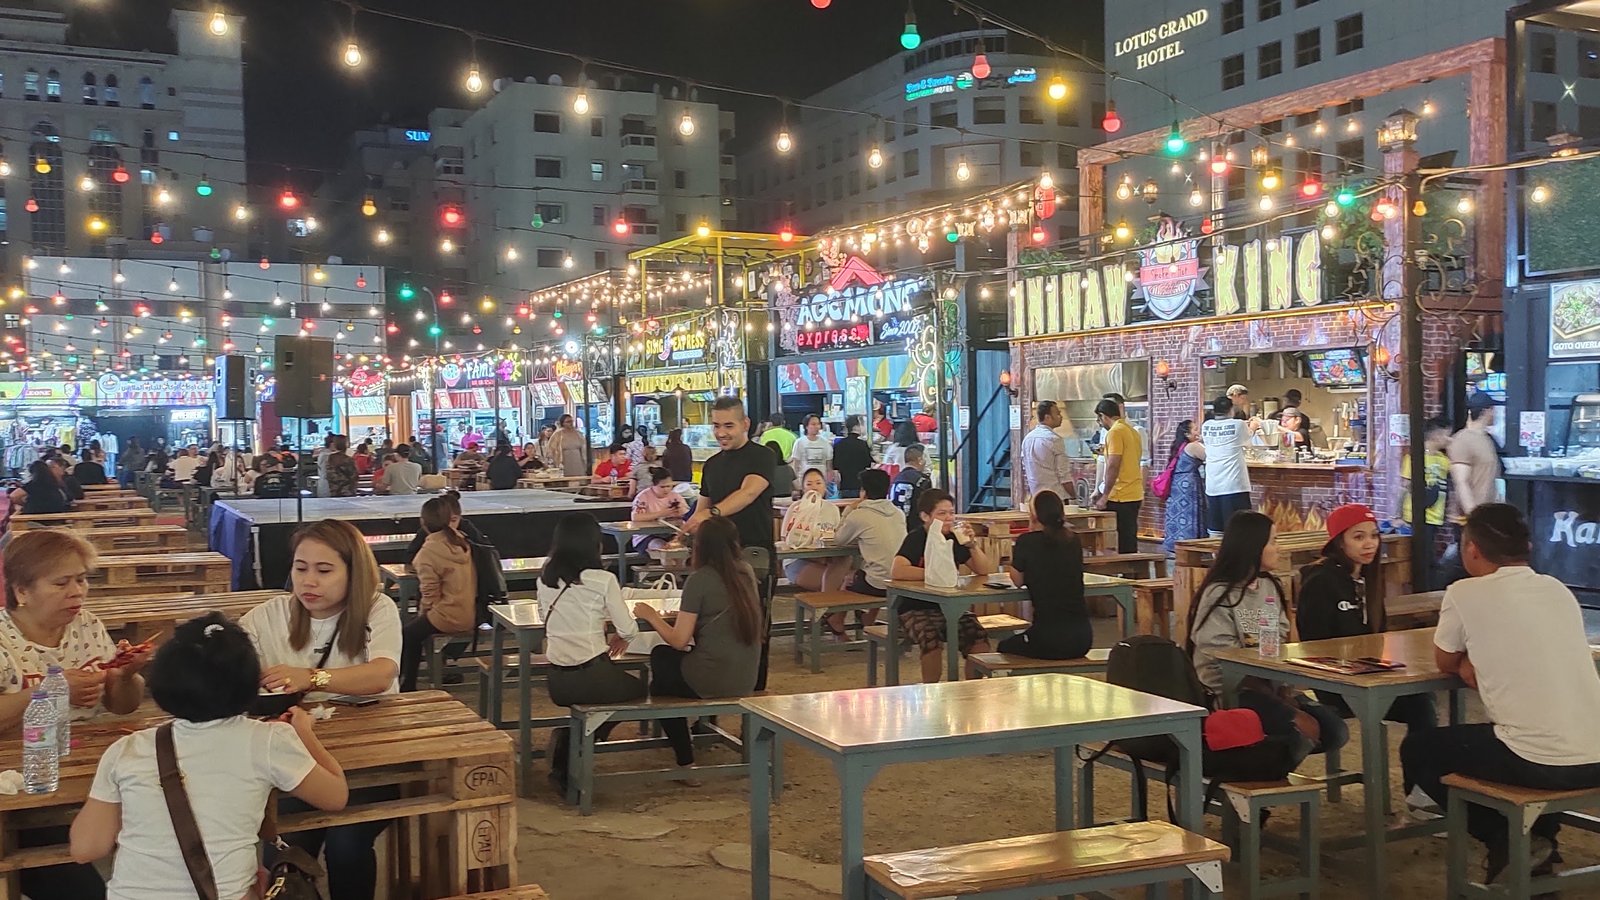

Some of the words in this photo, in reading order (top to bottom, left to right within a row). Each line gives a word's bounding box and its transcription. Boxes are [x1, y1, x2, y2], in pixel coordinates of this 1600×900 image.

[1115, 28, 1157, 57] LOTUS
[1159, 9, 1208, 40] GRAND
[1136, 41, 1185, 70] HOTEL
[933, 85, 955, 95] HOTEL
[405, 130, 431, 141] SUN
[1013, 264, 1127, 338] INIHAW
[1212, 229, 1322, 317] KING
[797, 326, 858, 349] express
[879, 322, 899, 340] Since
[672, 332, 706, 352] EXPRESS
[1553, 342, 1573, 351] GOTO
[472, 771, 501, 787] EPAL
